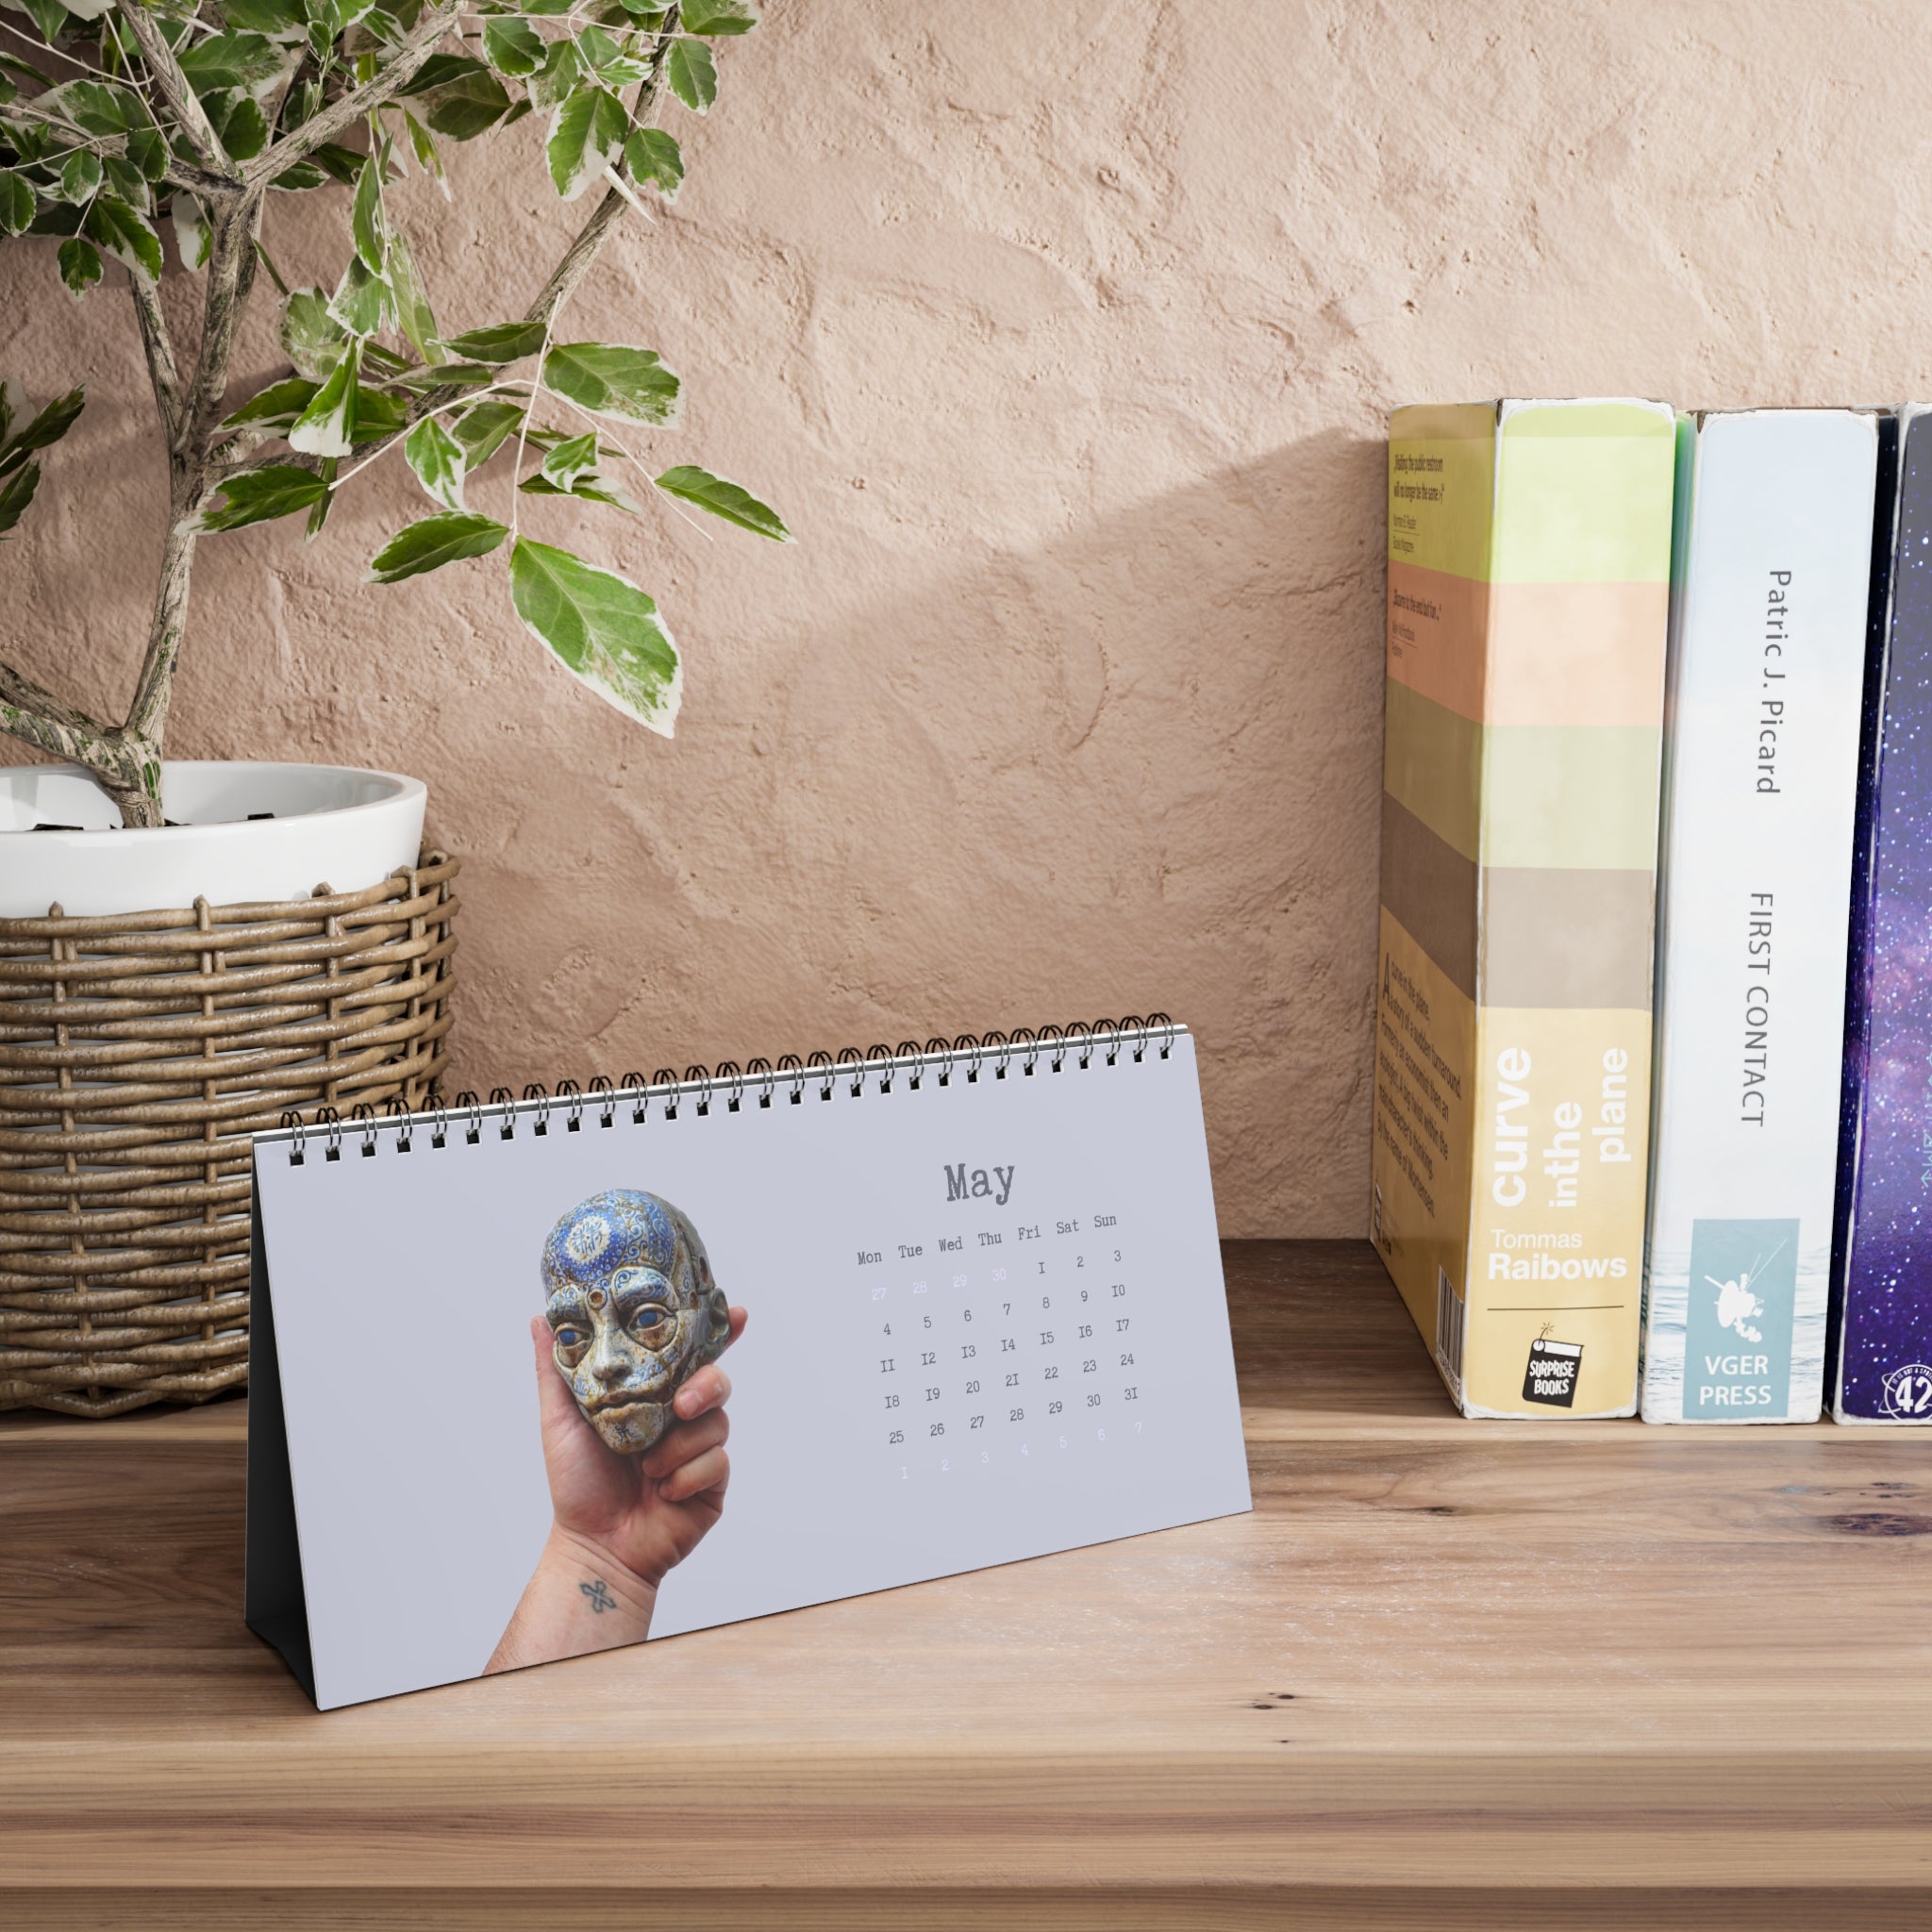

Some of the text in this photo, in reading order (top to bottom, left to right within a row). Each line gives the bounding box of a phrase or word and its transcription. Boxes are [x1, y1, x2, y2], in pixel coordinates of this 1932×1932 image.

[1757, 571, 1791, 793] Patric J. Picard
[1740, 893, 1774, 1127] FIRST CONTACT
[1591, 1047, 1632, 1163] plane
[1491, 1047, 1532, 1208] curve
[943, 1163, 1014, 1206] May
[857, 1215, 1118, 1266] Mon Tue Wed Thu Fri Sat Sun
[1491, 1228, 1583, 1249] Tommas
[871, 1287, 887, 1302] 27
[912, 1281, 928, 1294] 28
[952, 1274, 967, 1288] 29
[991, 1268, 1008, 1282] 30
[1076, 1256, 1085, 1269] 2
[1113, 1249, 1122, 1262] 3
[1488, 1252, 1627, 1280] Raibows
[883, 1323, 891, 1336] 4
[923, 1315, 932, 1329] 5
[963, 1309, 973, 1323] 6
[1003, 1302, 1011, 1316] 7
[1041, 1296, 1051, 1309] 8
[1080, 1290, 1089, 1303] 9
[966, 1381, 980, 1394] 20
[1044, 1367, 1059, 1380] 22
[1082, 1359, 1097, 1374] 23
[1120, 1354, 1135, 1367] 24
[1529, 1359, 1575, 1378] SURPRISE
[1534, 1378, 1570, 1396] BOOKS
[1705, 1355, 1769, 1375] VGER
[1699, 1385, 1772, 1406] PRESS
[1895, 1375, 1932, 1413] 42
[889, 1430, 905, 1445] 25
[929, 1424, 945, 1438] 26
[970, 1416, 985, 1430] 27
[1009, 1408, 1024, 1423] 28
[1048, 1401, 1063, 1415] 29
[1087, 1394, 1101, 1407] 30
[941, 1458, 951, 1473] 2
[981, 1450, 990, 1464] 3
[1020, 1442, 1029, 1457] 4
[1058, 1435, 1068, 1449] 5
[1097, 1428, 1107, 1441] 6
[1134, 1421, 1142, 1435] 7
